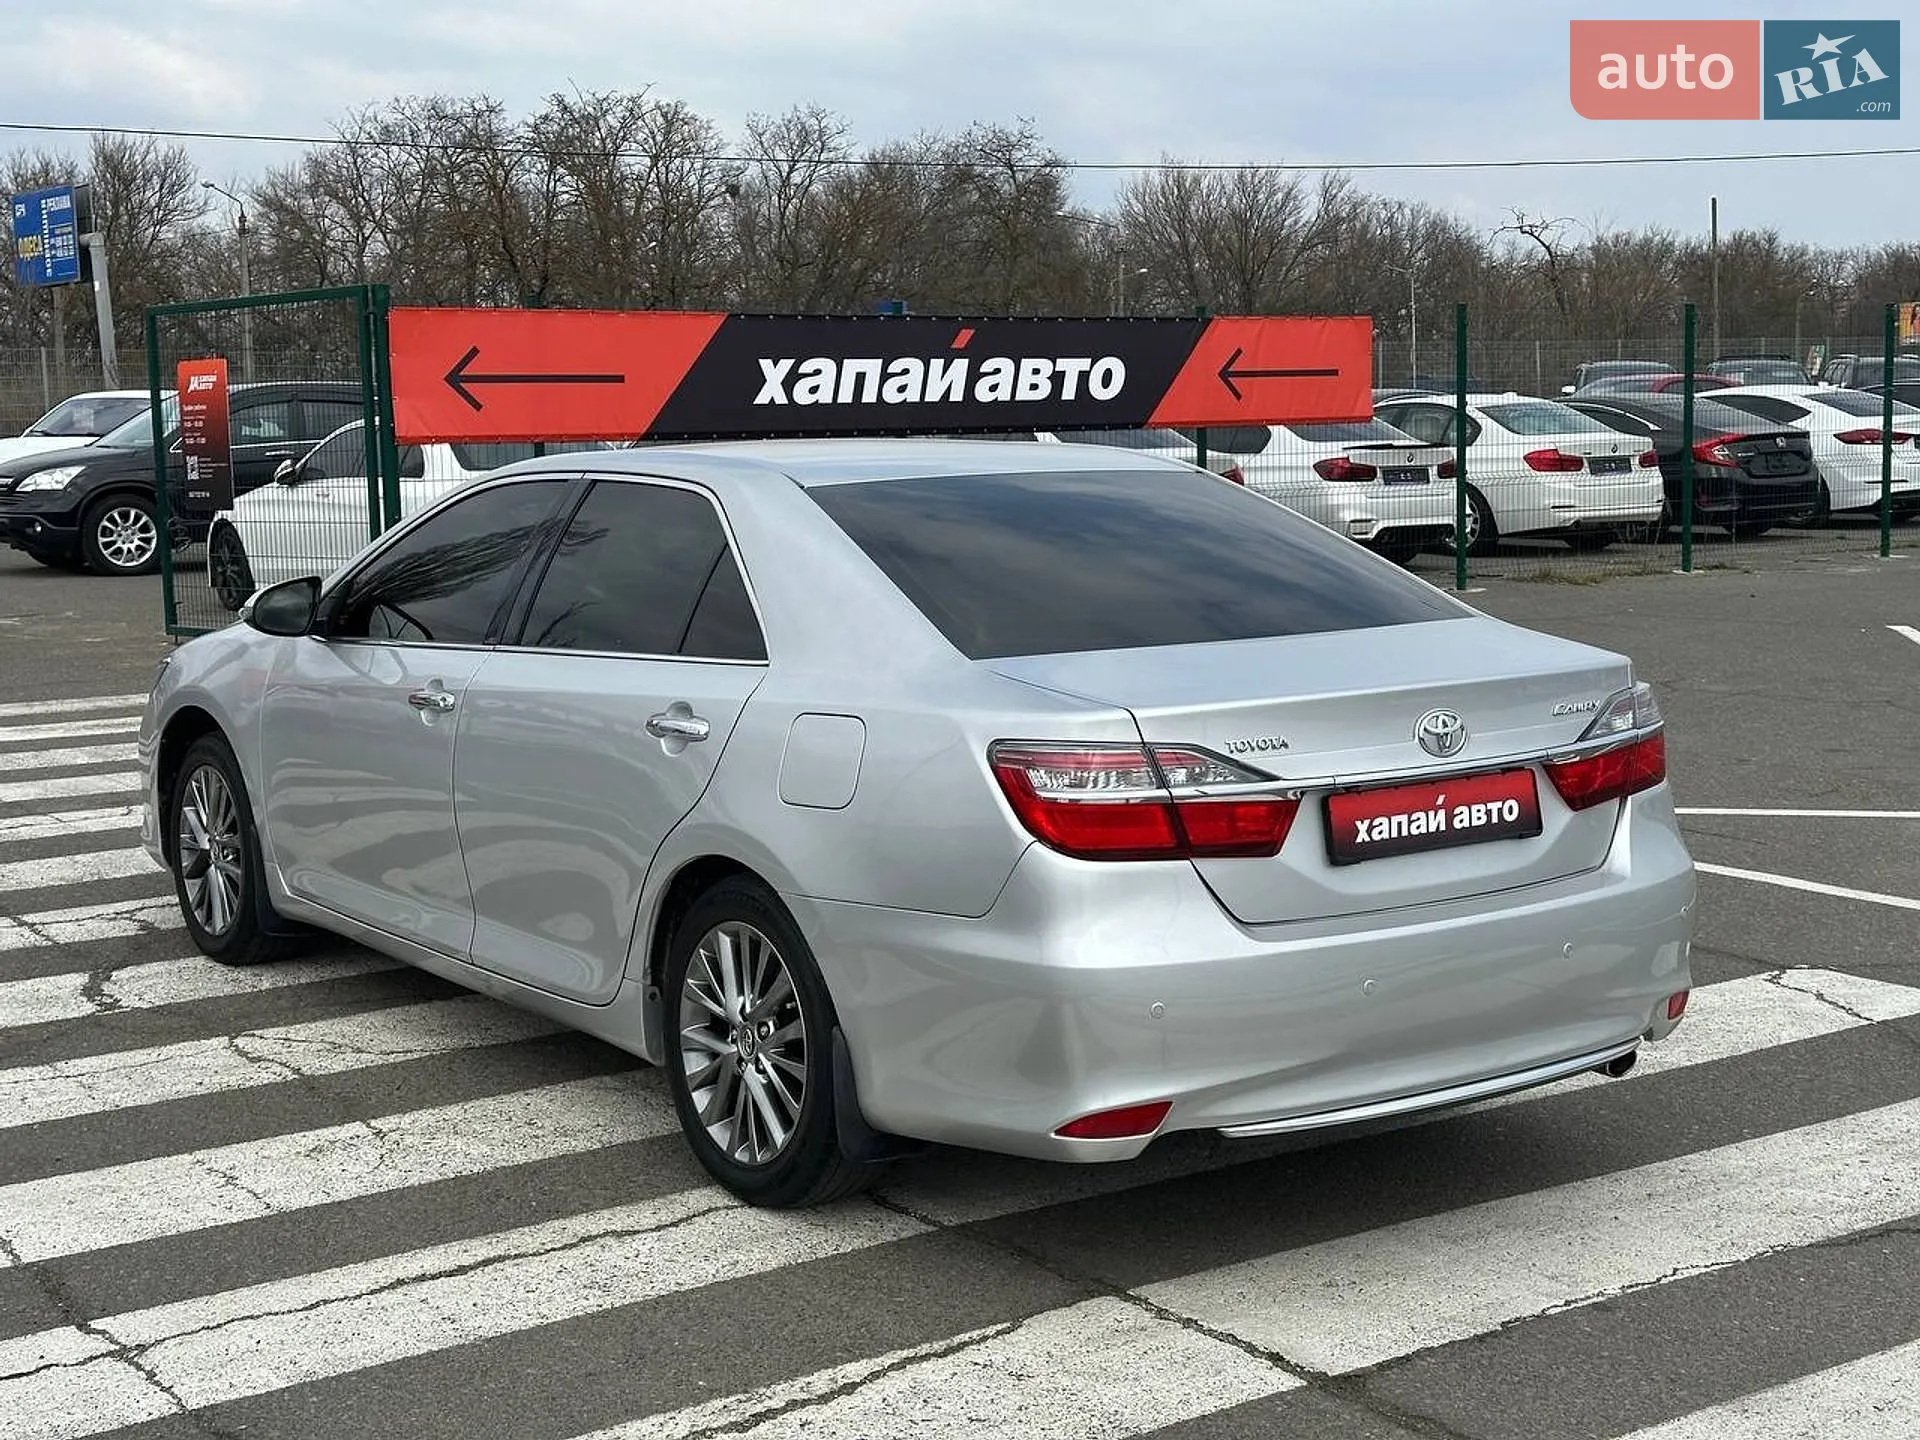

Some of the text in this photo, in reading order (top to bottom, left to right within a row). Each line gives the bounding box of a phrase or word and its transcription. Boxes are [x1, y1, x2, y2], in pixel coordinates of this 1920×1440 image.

[974, 356, 1127, 403] авто
[1551, 699, 1600, 716] CAMRY
[1224, 736, 1290, 755] TOYOTA
[1453, 799, 1519, 830] авто
